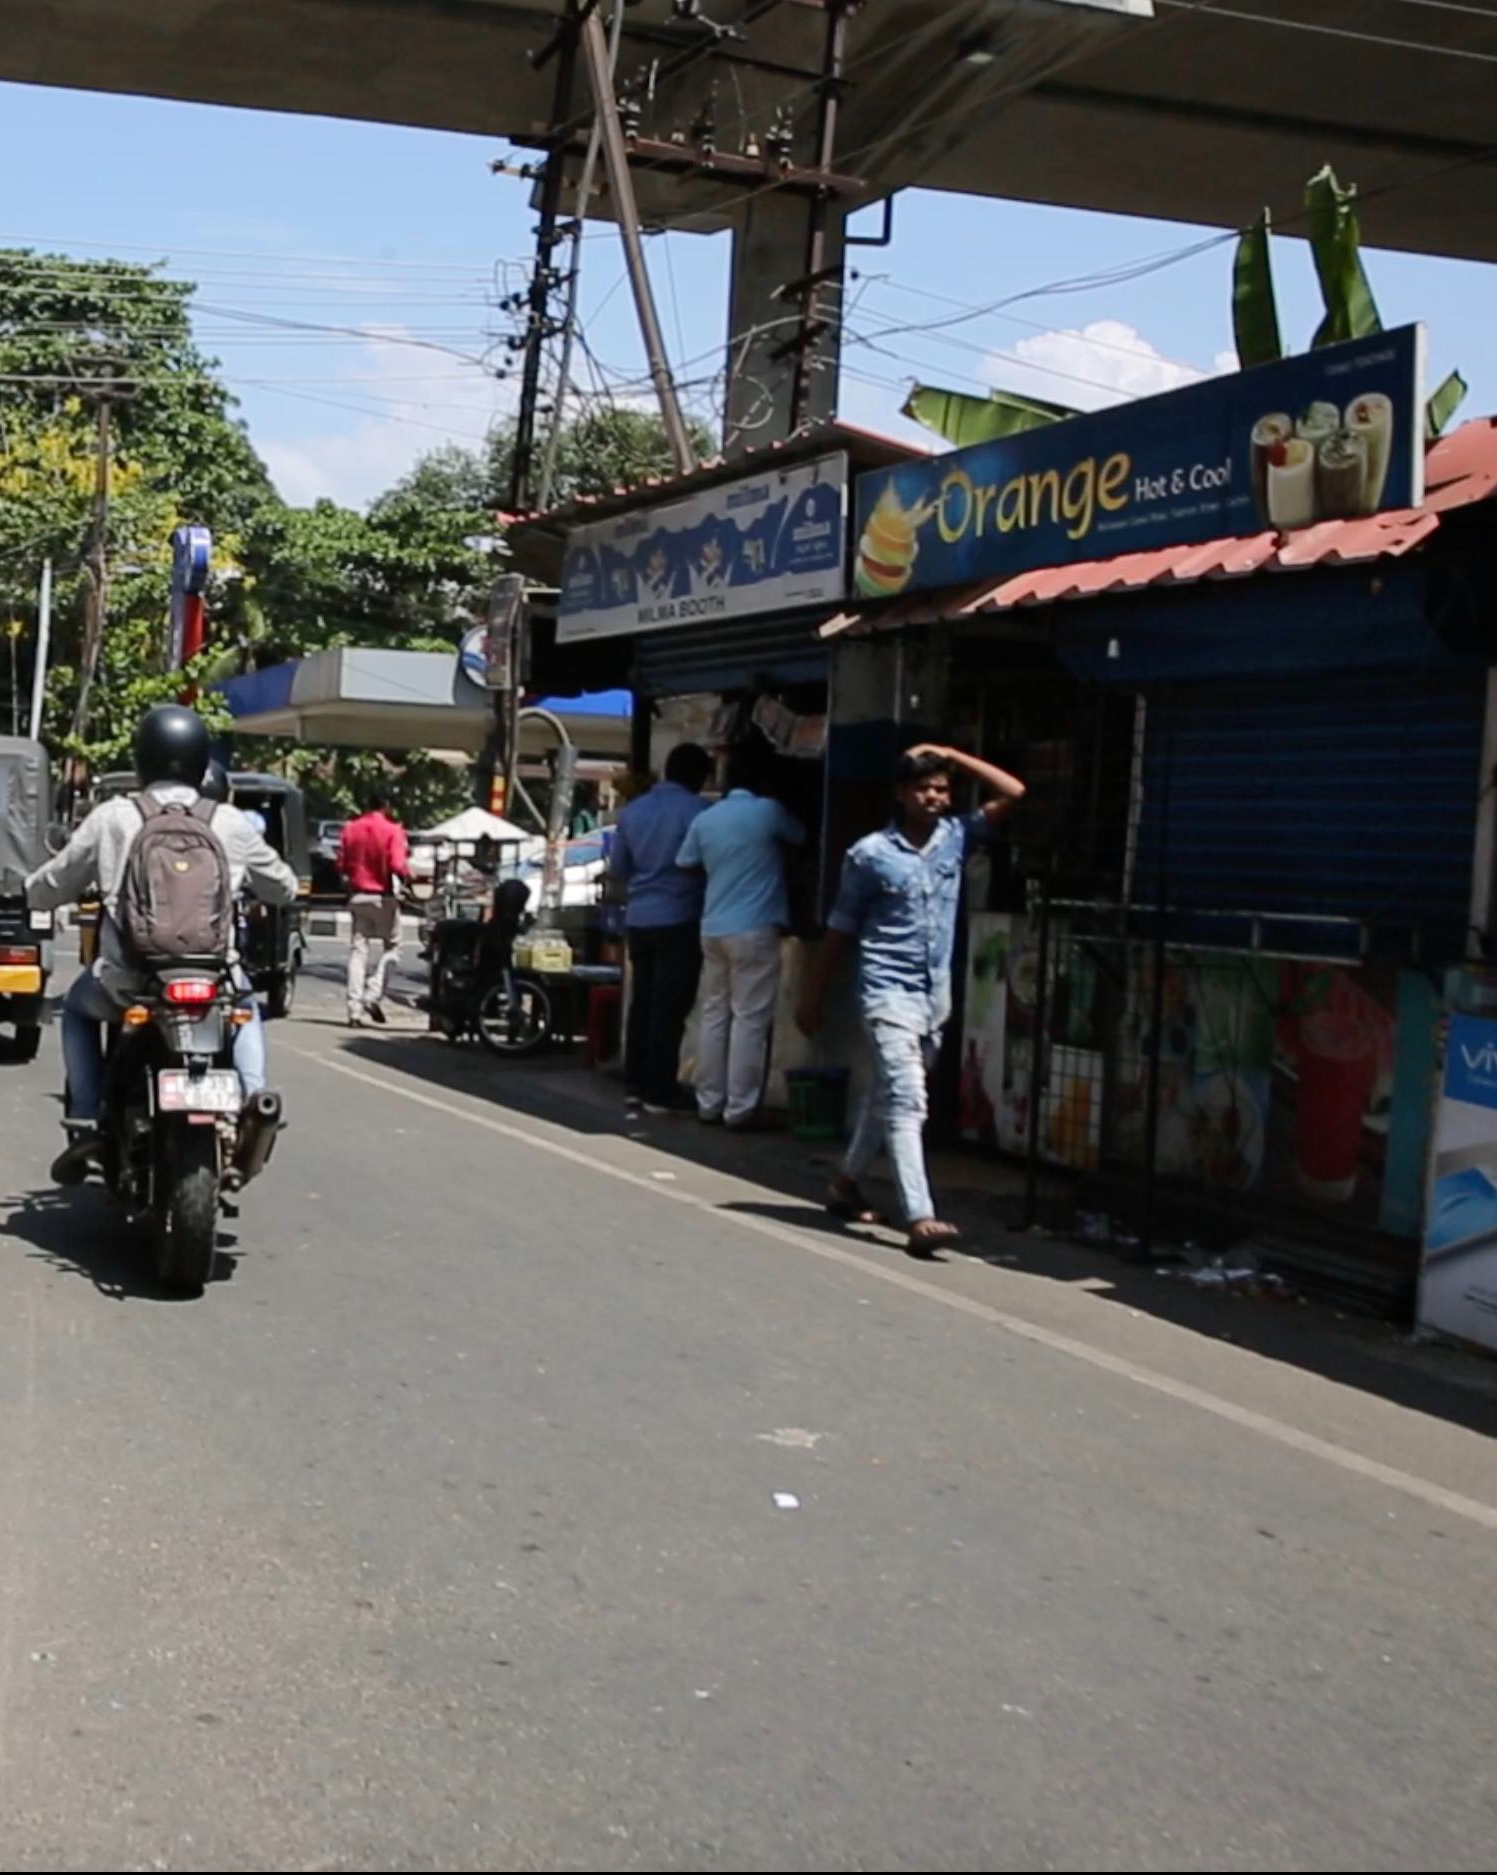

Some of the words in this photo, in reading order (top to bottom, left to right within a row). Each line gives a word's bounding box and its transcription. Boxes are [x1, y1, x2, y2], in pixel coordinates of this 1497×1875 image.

[937, 452, 1131, 543] Orange
[1135, 476, 1167, 502] Hot
[1170, 468, 1185, 495] &
[1188, 457, 1232, 491] Cool
[679, 594, 726, 618] BOOTH
